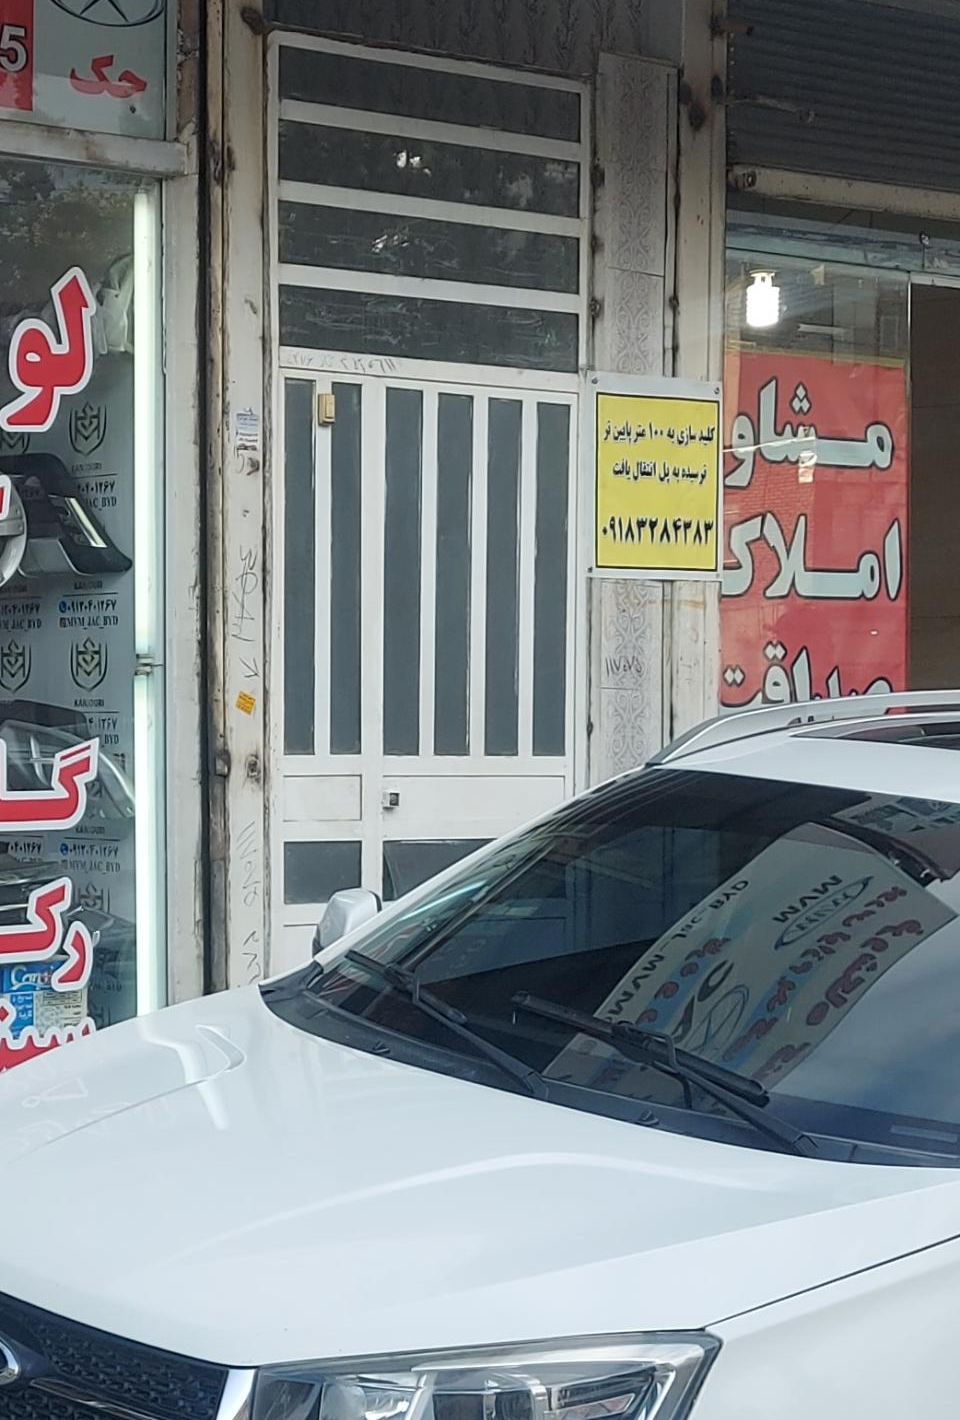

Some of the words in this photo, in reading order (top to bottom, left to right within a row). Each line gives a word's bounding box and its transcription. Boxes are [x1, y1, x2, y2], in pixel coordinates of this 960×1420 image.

[612, 458, 631, 481] یافت
[632, 460, 657, 482] انتقال
[722, 511, 902, 601] املاک
